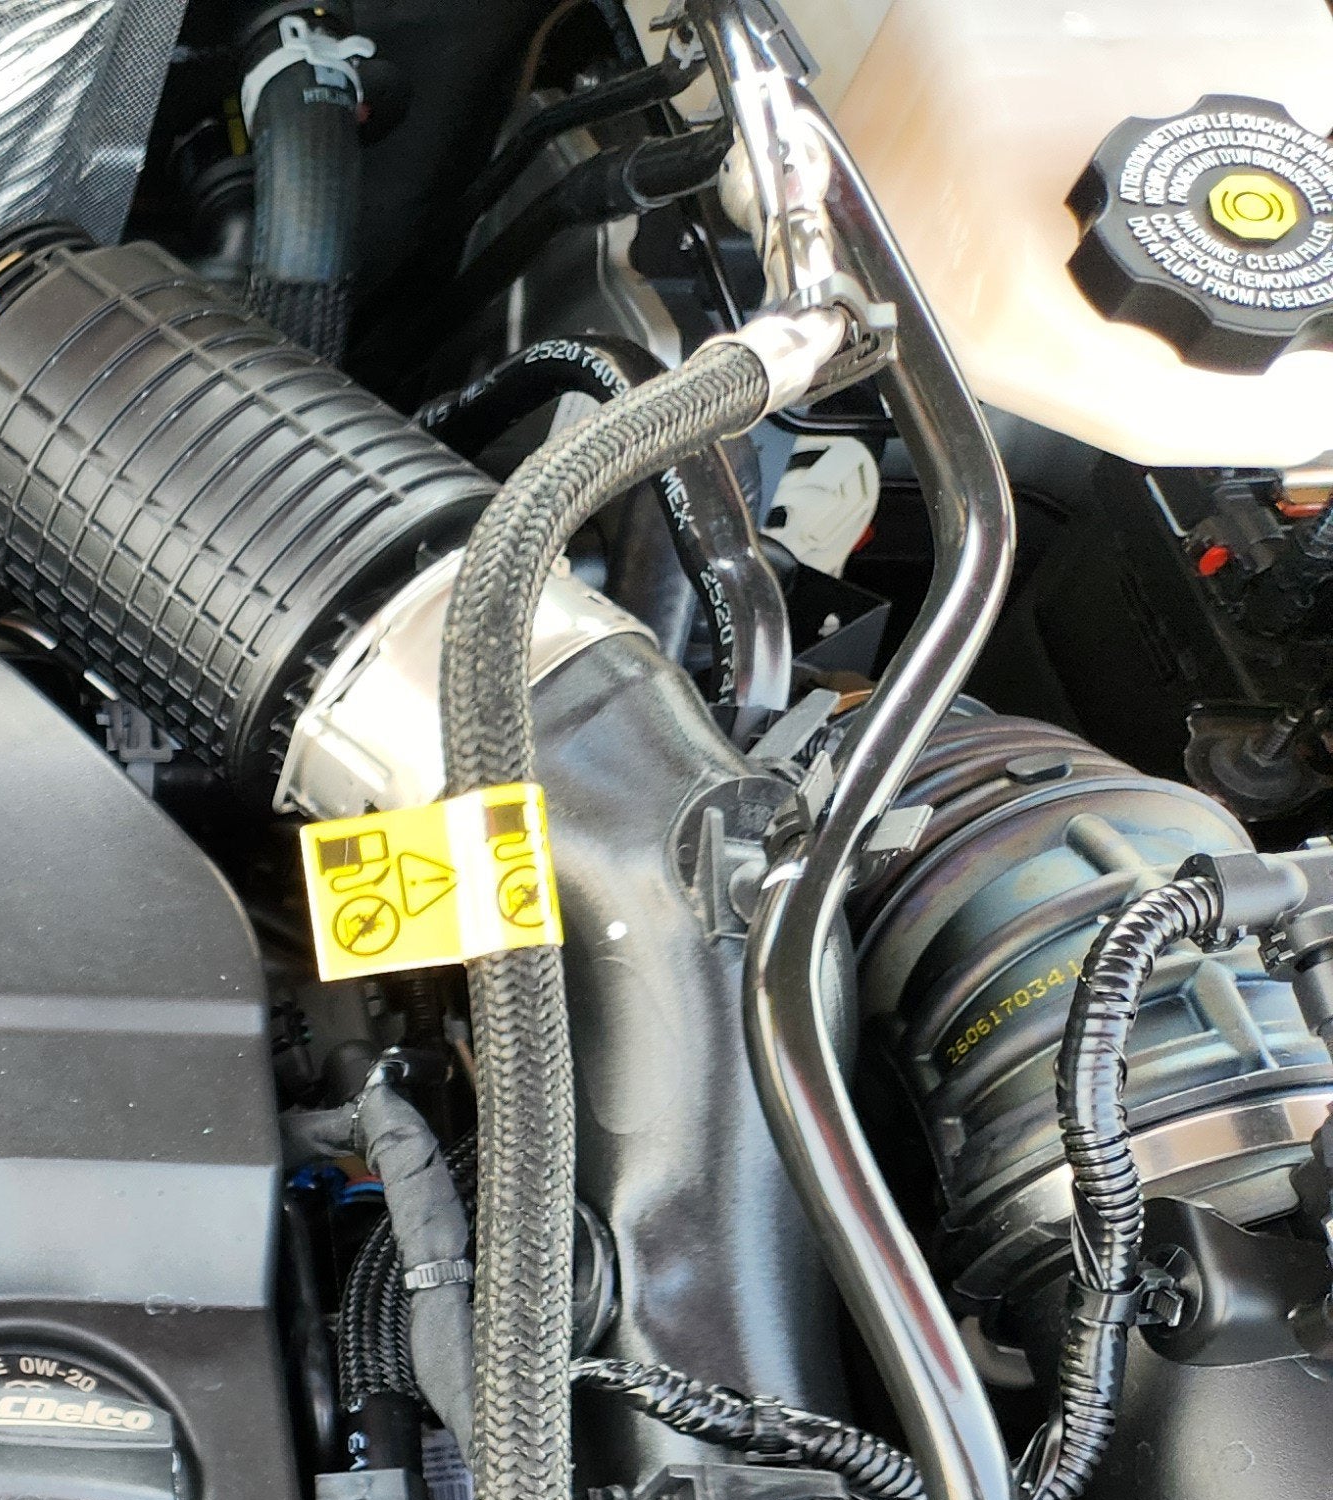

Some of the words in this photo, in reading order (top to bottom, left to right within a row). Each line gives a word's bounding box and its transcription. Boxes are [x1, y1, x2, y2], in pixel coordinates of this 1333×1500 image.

[1296, 133, 1333, 168] AVAN
[1150, 214, 1182, 240] CAP
[1171, 238, 1234, 282] BEFORE
[1233, 265, 1320, 290] REMOVING
[1245, 251, 1304, 271] CLEAN
[1295, 221, 1333, 261] FILLER
[1154, 249, 1204, 286] FLUID
[1202, 277, 1255, 306] FROM
[1255, 291, 1271, 308] A
[19, 1357, 97, 1393] 0W-20
